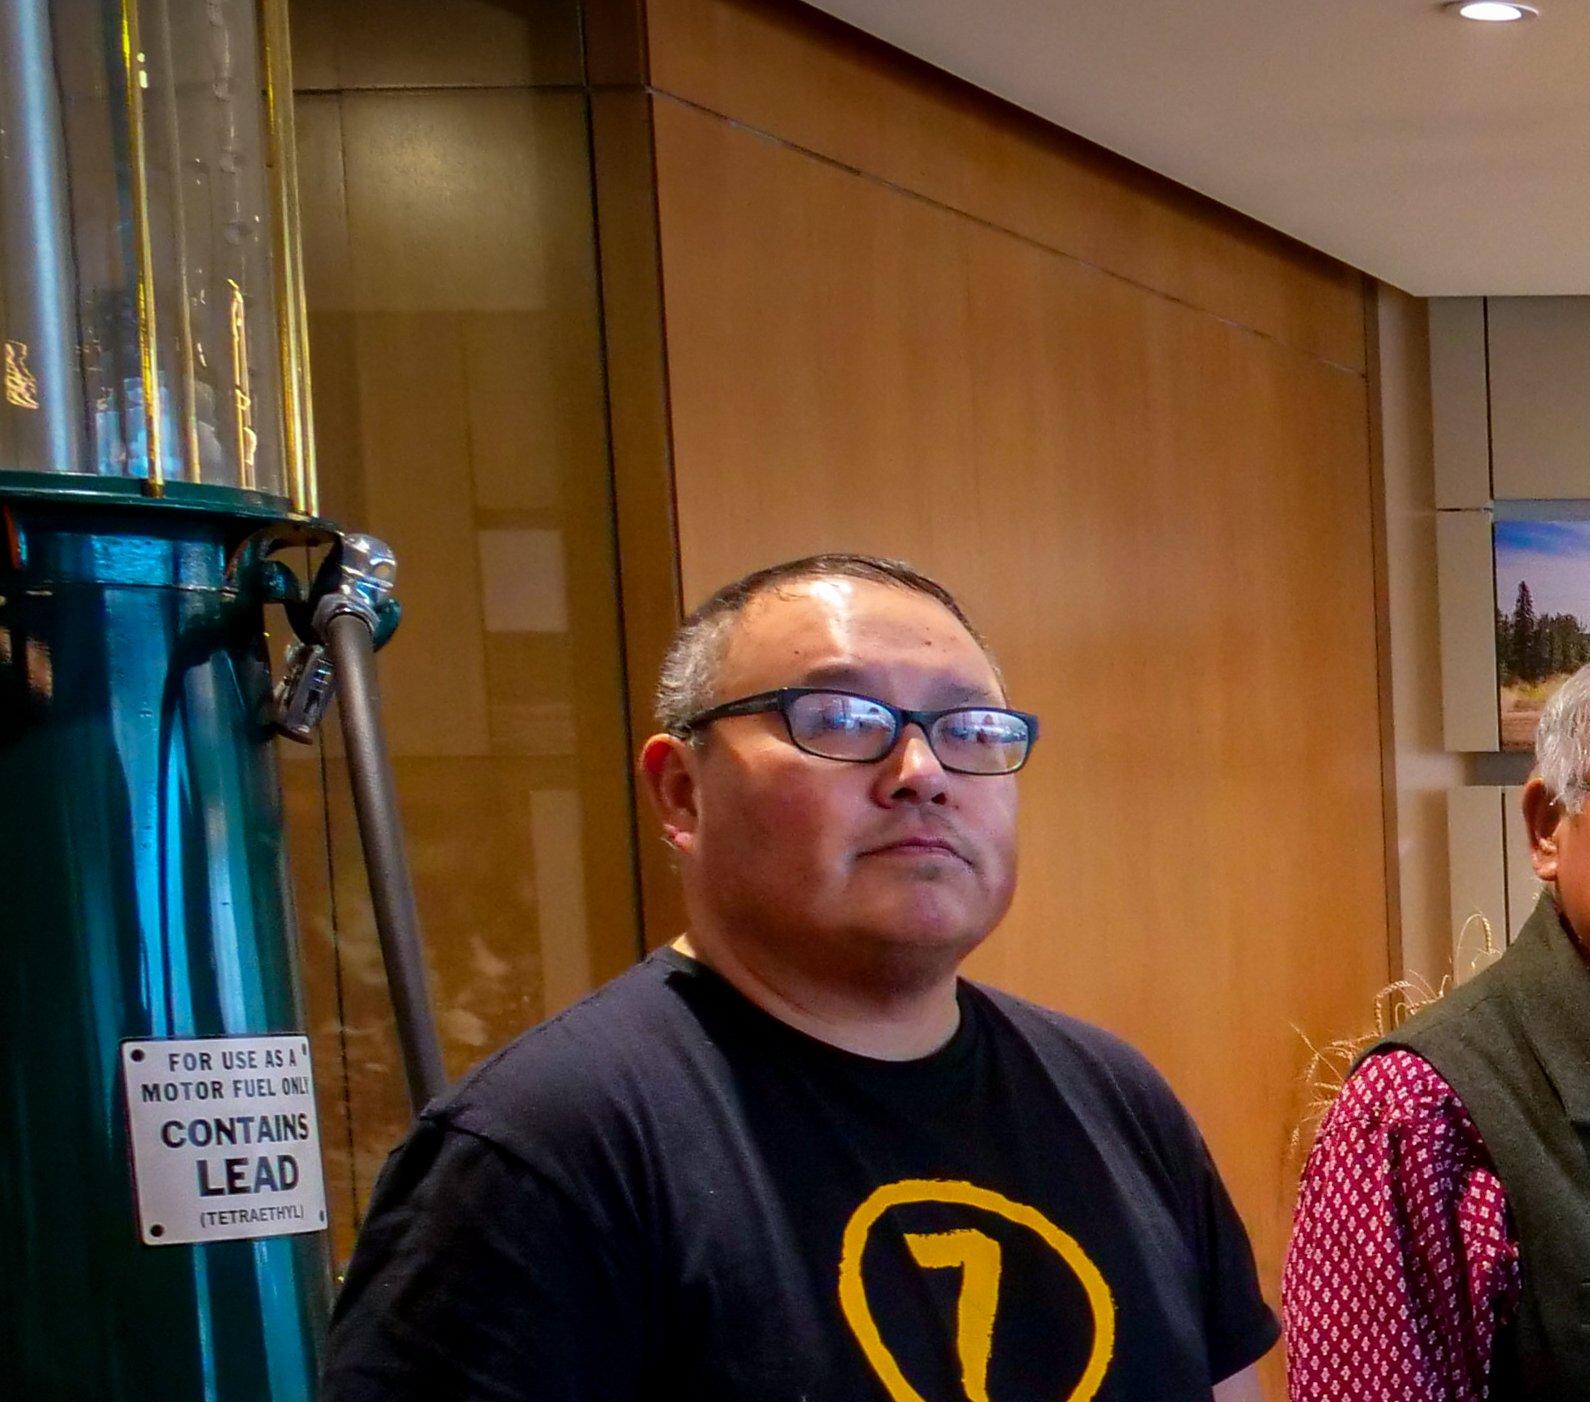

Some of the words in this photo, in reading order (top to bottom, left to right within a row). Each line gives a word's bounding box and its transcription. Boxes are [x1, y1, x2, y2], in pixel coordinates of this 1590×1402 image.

[169, 1052, 213, 1073] FOR
[223, 1050, 258, 1070] USE
[265, 1049, 284, 1068] AS
[289, 1048, 297, 1067] A
[141, 1080, 225, 1103] MOTOR
[233, 1078, 277, 1099] FUEL
[281, 1076, 309, 1096] ONLY
[160, 1112, 310, 1149] CONTAINS
[195, 1154, 301, 1198] LEAD
[200, 1205, 305, 1229] (TETRAETHYL)
